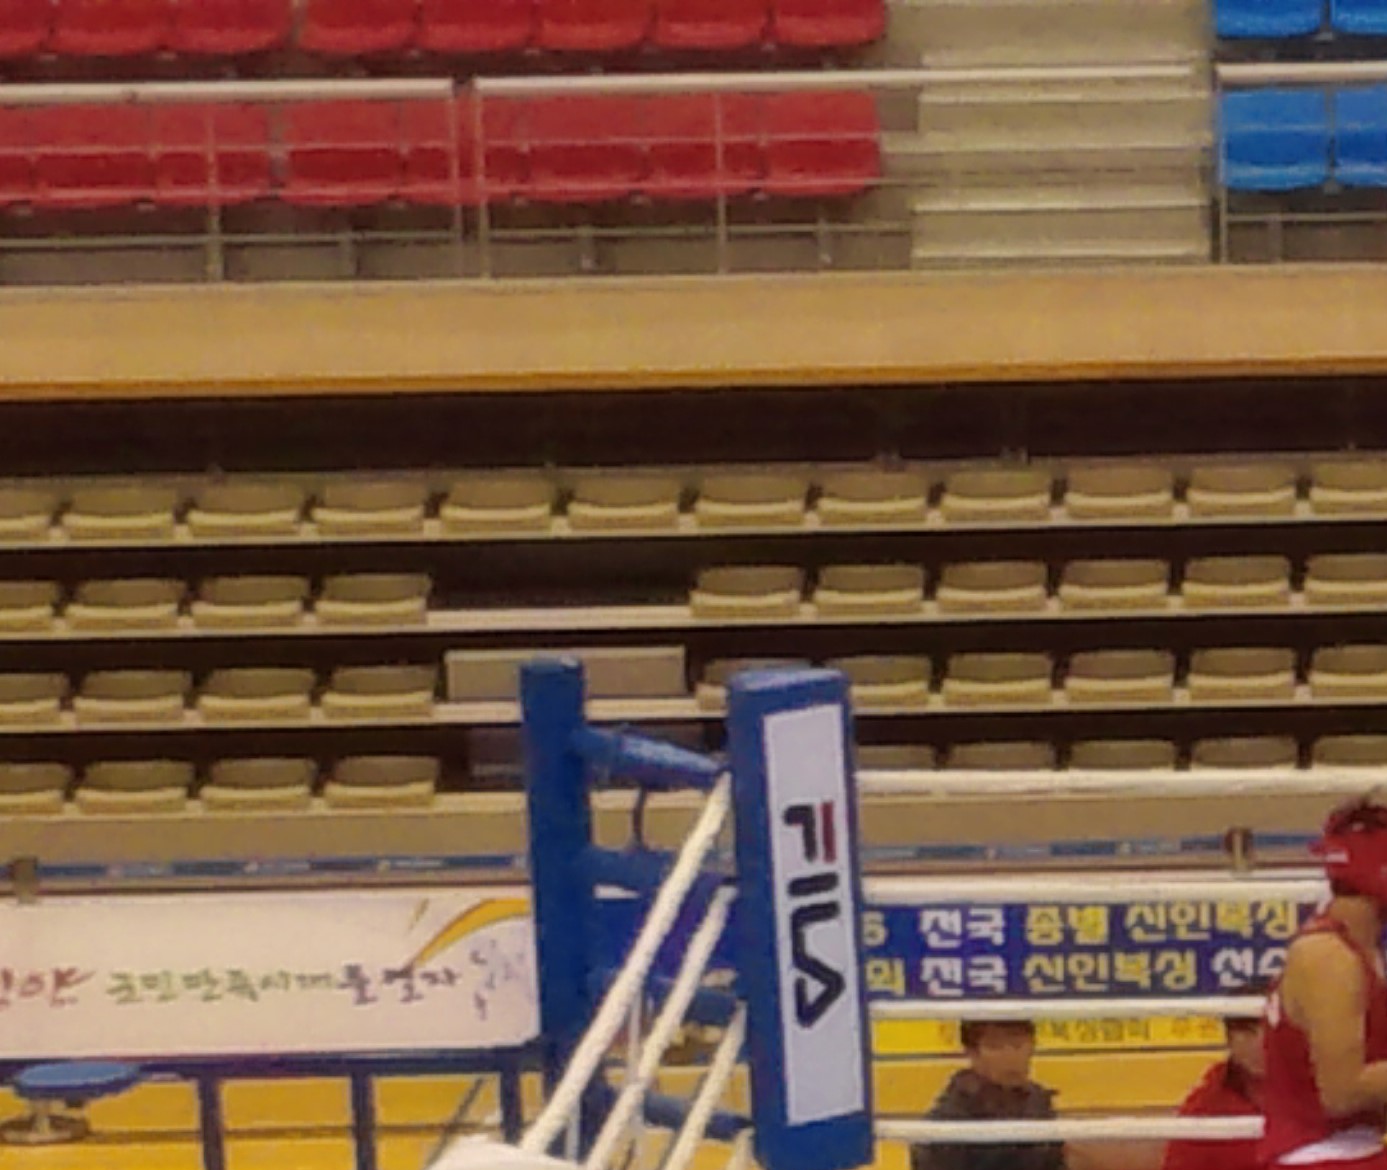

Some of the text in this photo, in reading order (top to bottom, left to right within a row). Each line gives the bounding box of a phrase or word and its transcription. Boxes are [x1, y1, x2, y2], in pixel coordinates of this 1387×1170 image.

[782, 799, 846, 1029] FILA
[919, 908, 1005, 948] 전국
[1124, 900, 1300, 943] 신인복싱
[920, 956, 1006, 997] 전국
[1023, 948, 1198, 994] 신인복싱
